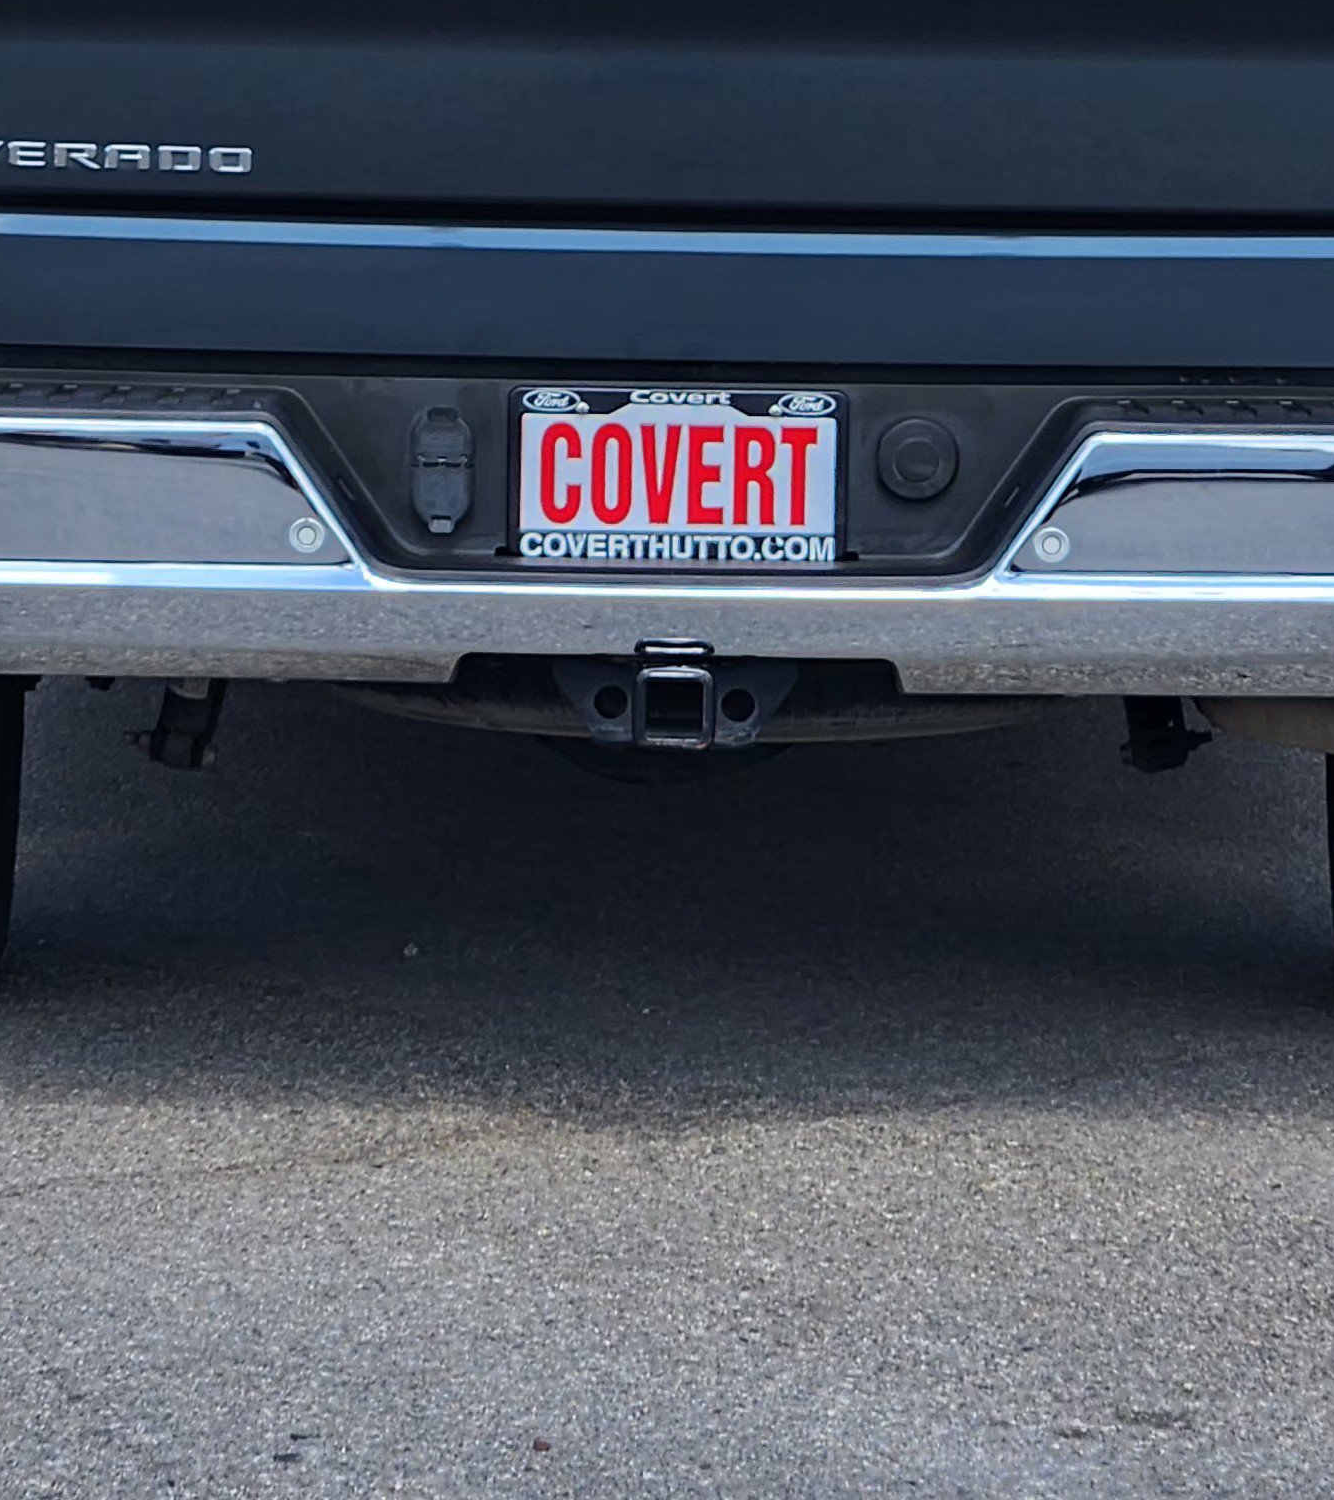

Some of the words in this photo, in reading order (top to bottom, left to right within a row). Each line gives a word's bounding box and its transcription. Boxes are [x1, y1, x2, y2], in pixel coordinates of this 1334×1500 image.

[629, 389, 732, 405] Covert
[540, 422, 818, 526] COVERT
[519, 532, 835, 562] COVERTHUTTO.COM
